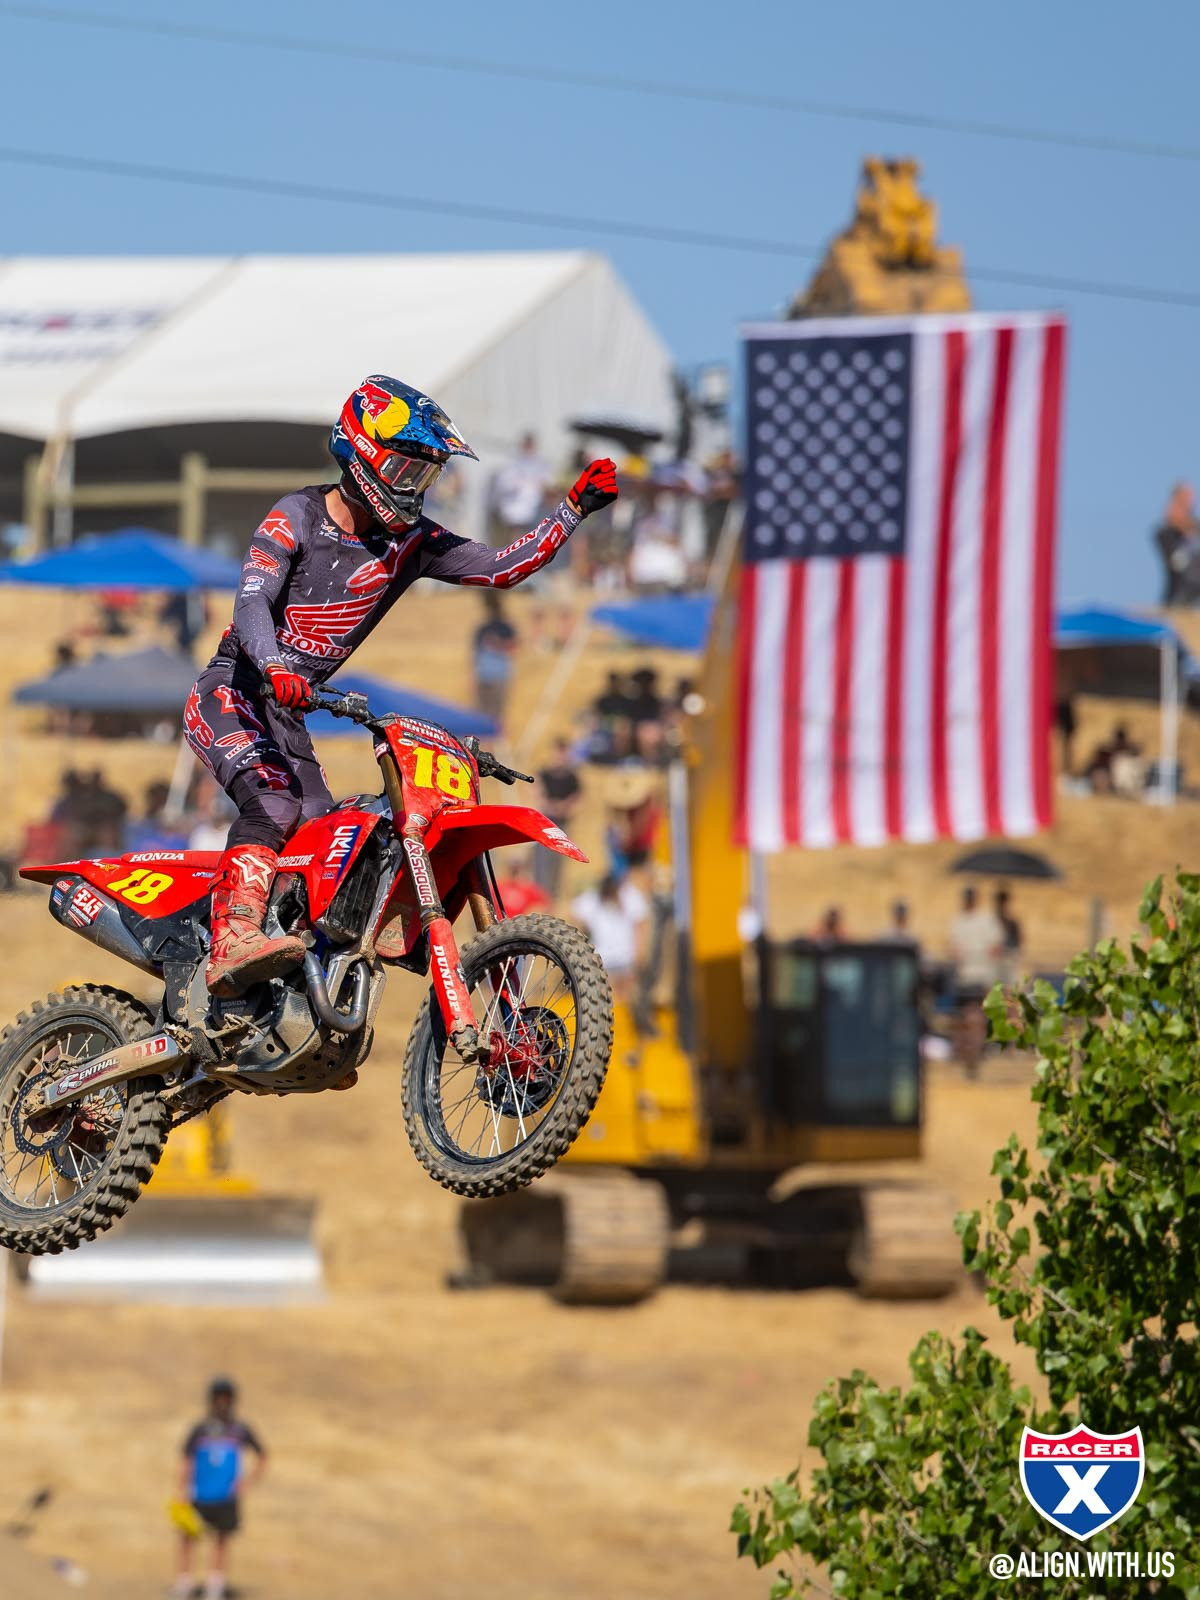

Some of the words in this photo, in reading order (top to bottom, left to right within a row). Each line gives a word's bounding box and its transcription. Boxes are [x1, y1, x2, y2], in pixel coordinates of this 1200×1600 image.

[355, 439, 375, 459] 100%
[349, 462, 375, 494] Red
[400, 720, 447, 743] RENTHAL
[412, 747, 472, 801] 18
[129, 852, 185, 863] HONDA
[326, 825, 358, 863] CRF
[106, 869, 174, 905] 18
[411, 854, 434, 906] SHOWA
[433, 944, 461, 1012] DUNLOP
